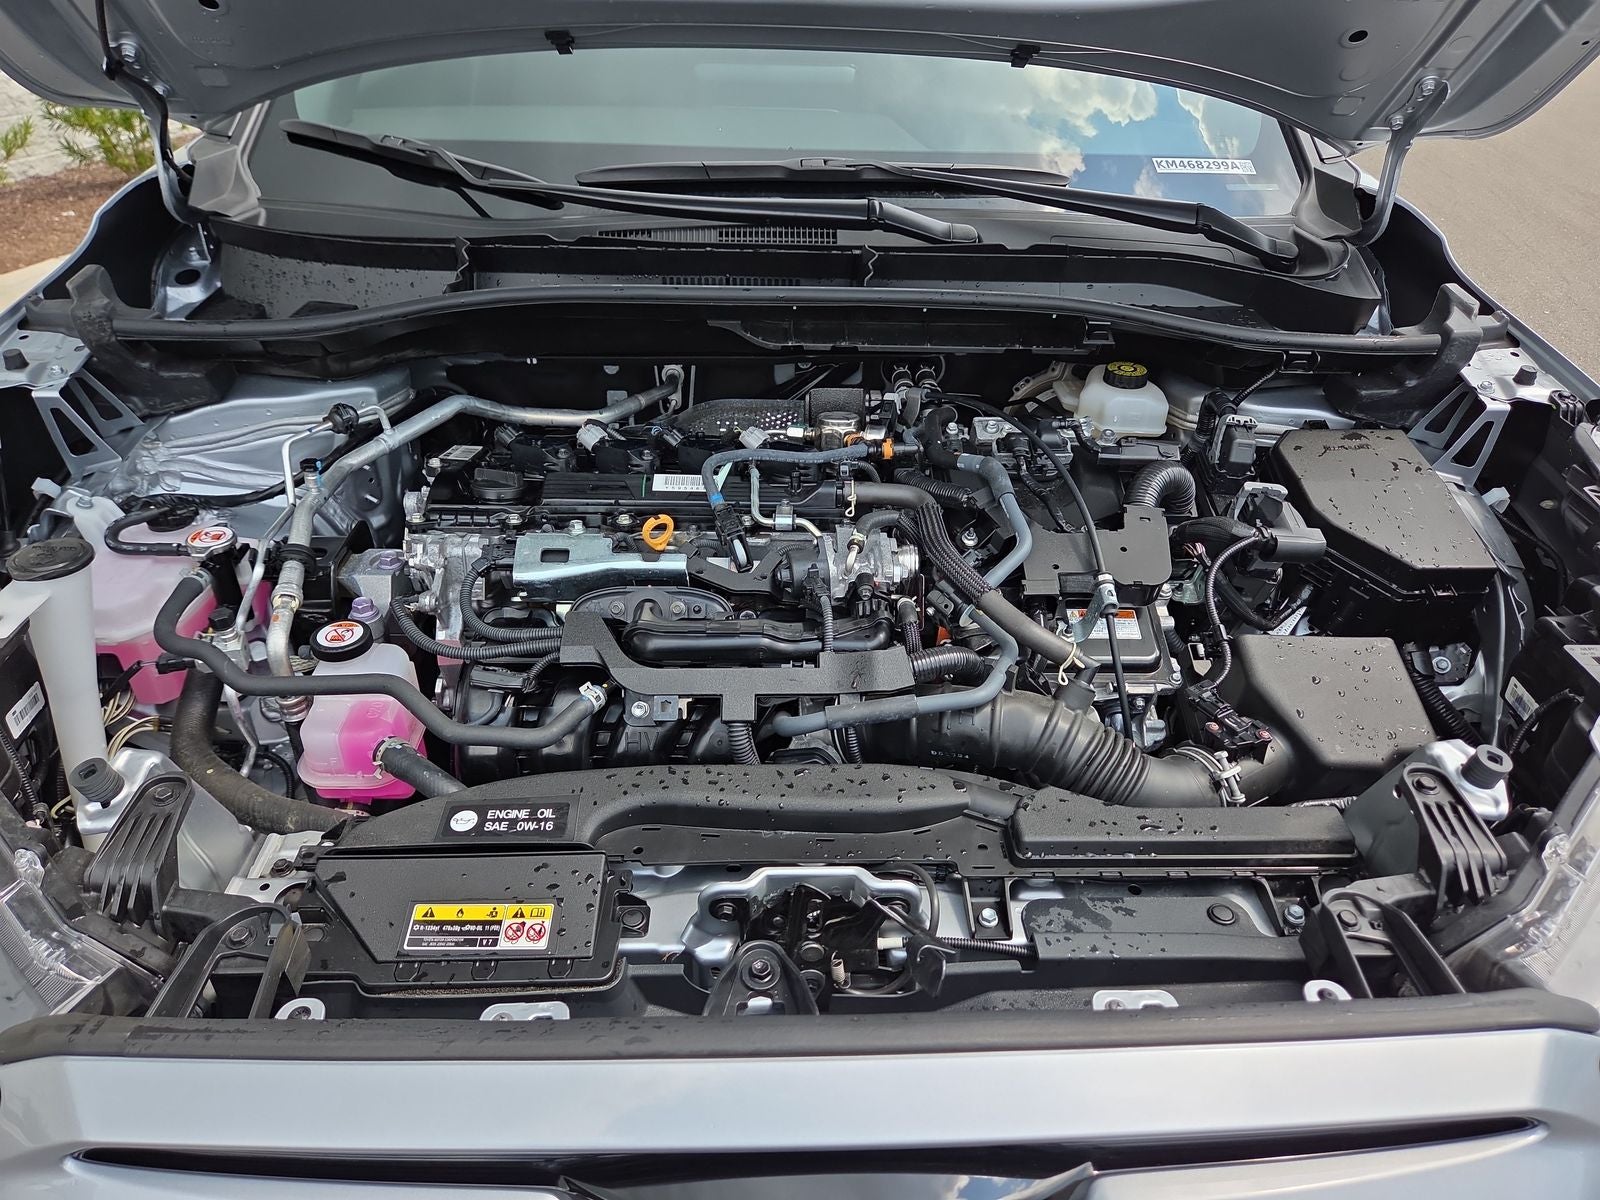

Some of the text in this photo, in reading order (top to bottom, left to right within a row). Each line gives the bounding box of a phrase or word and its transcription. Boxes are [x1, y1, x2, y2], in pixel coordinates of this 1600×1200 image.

[1155, 160, 1240, 170] KM468299A
[487, 808, 556, 819] ENGINE OIL
[483, 821, 554, 831] SAE 0W-16
